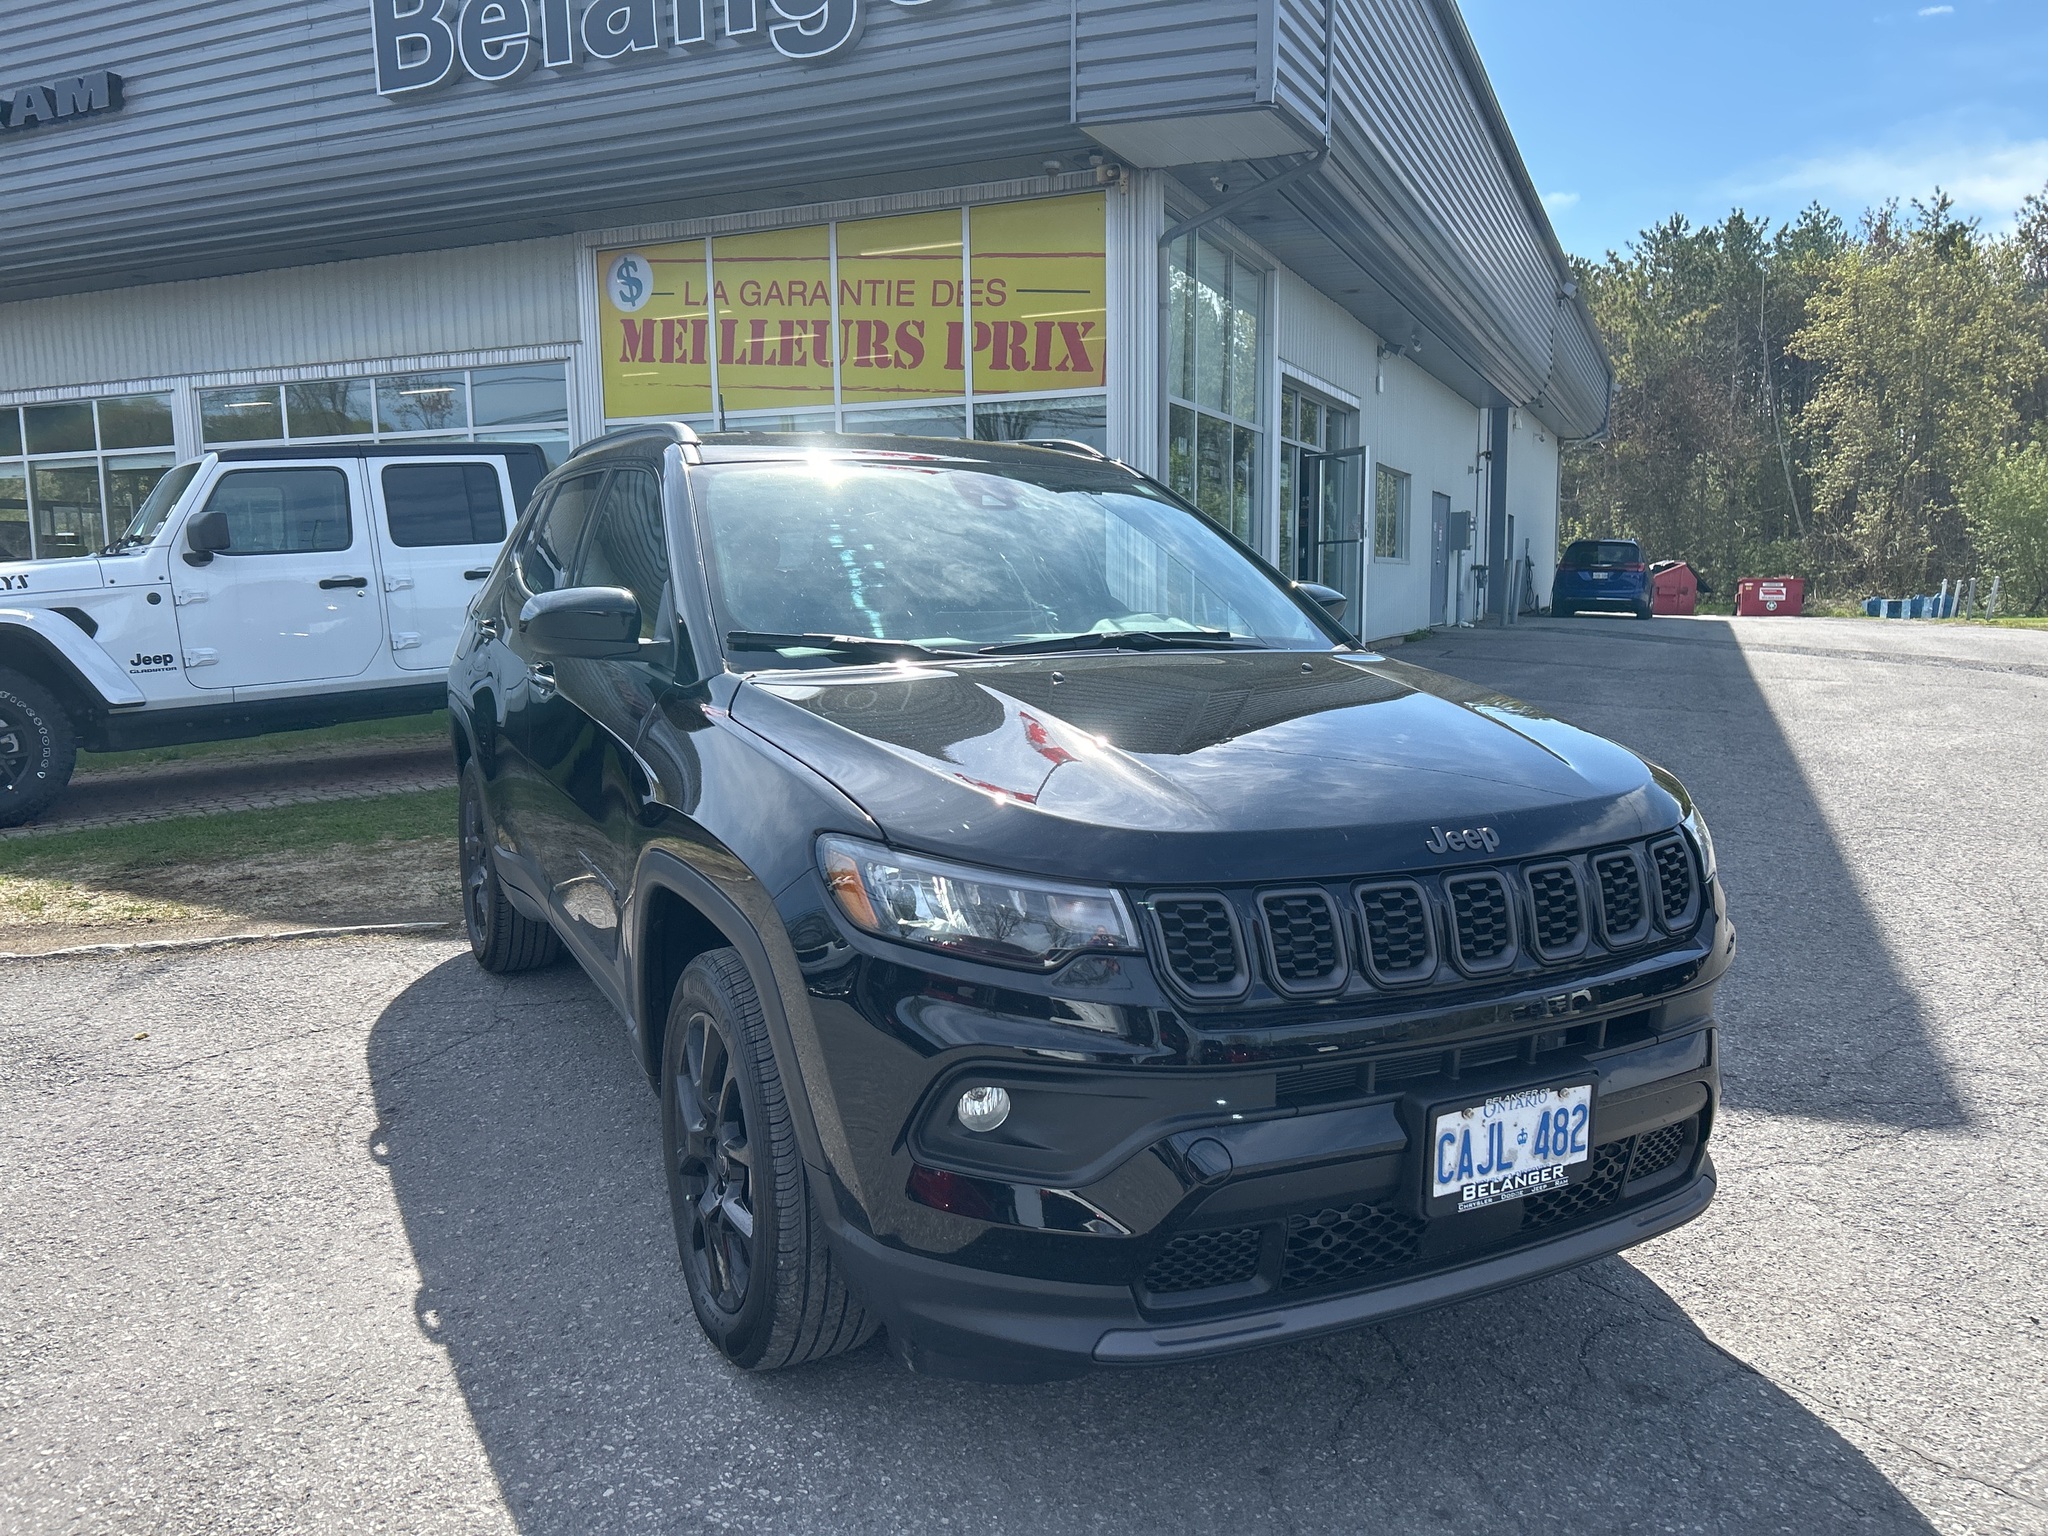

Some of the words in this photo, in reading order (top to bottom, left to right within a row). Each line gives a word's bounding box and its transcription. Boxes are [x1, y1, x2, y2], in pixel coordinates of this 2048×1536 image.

[0, 70, 110, 127] AM
[684, 279, 730, 307] LA
[740, 279, 916, 308] GARANTIE
[931, 278, 1008, 307] DES
[619, 318, 926, 371] MEILLEURS
[944, 320, 1096, 374] PRIX
[0, 575, 29, 590] YS
[130, 653, 174, 666] Jeep
[1425, 826, 1500, 854] Jeep
[1438, 1121, 1513, 1184] CAJL
[1534, 1104, 1588, 1160] 482
[1463, 1165, 1565, 1201] BELANGER
[1458, 1198, 1492, 1210] CHRYSLER
